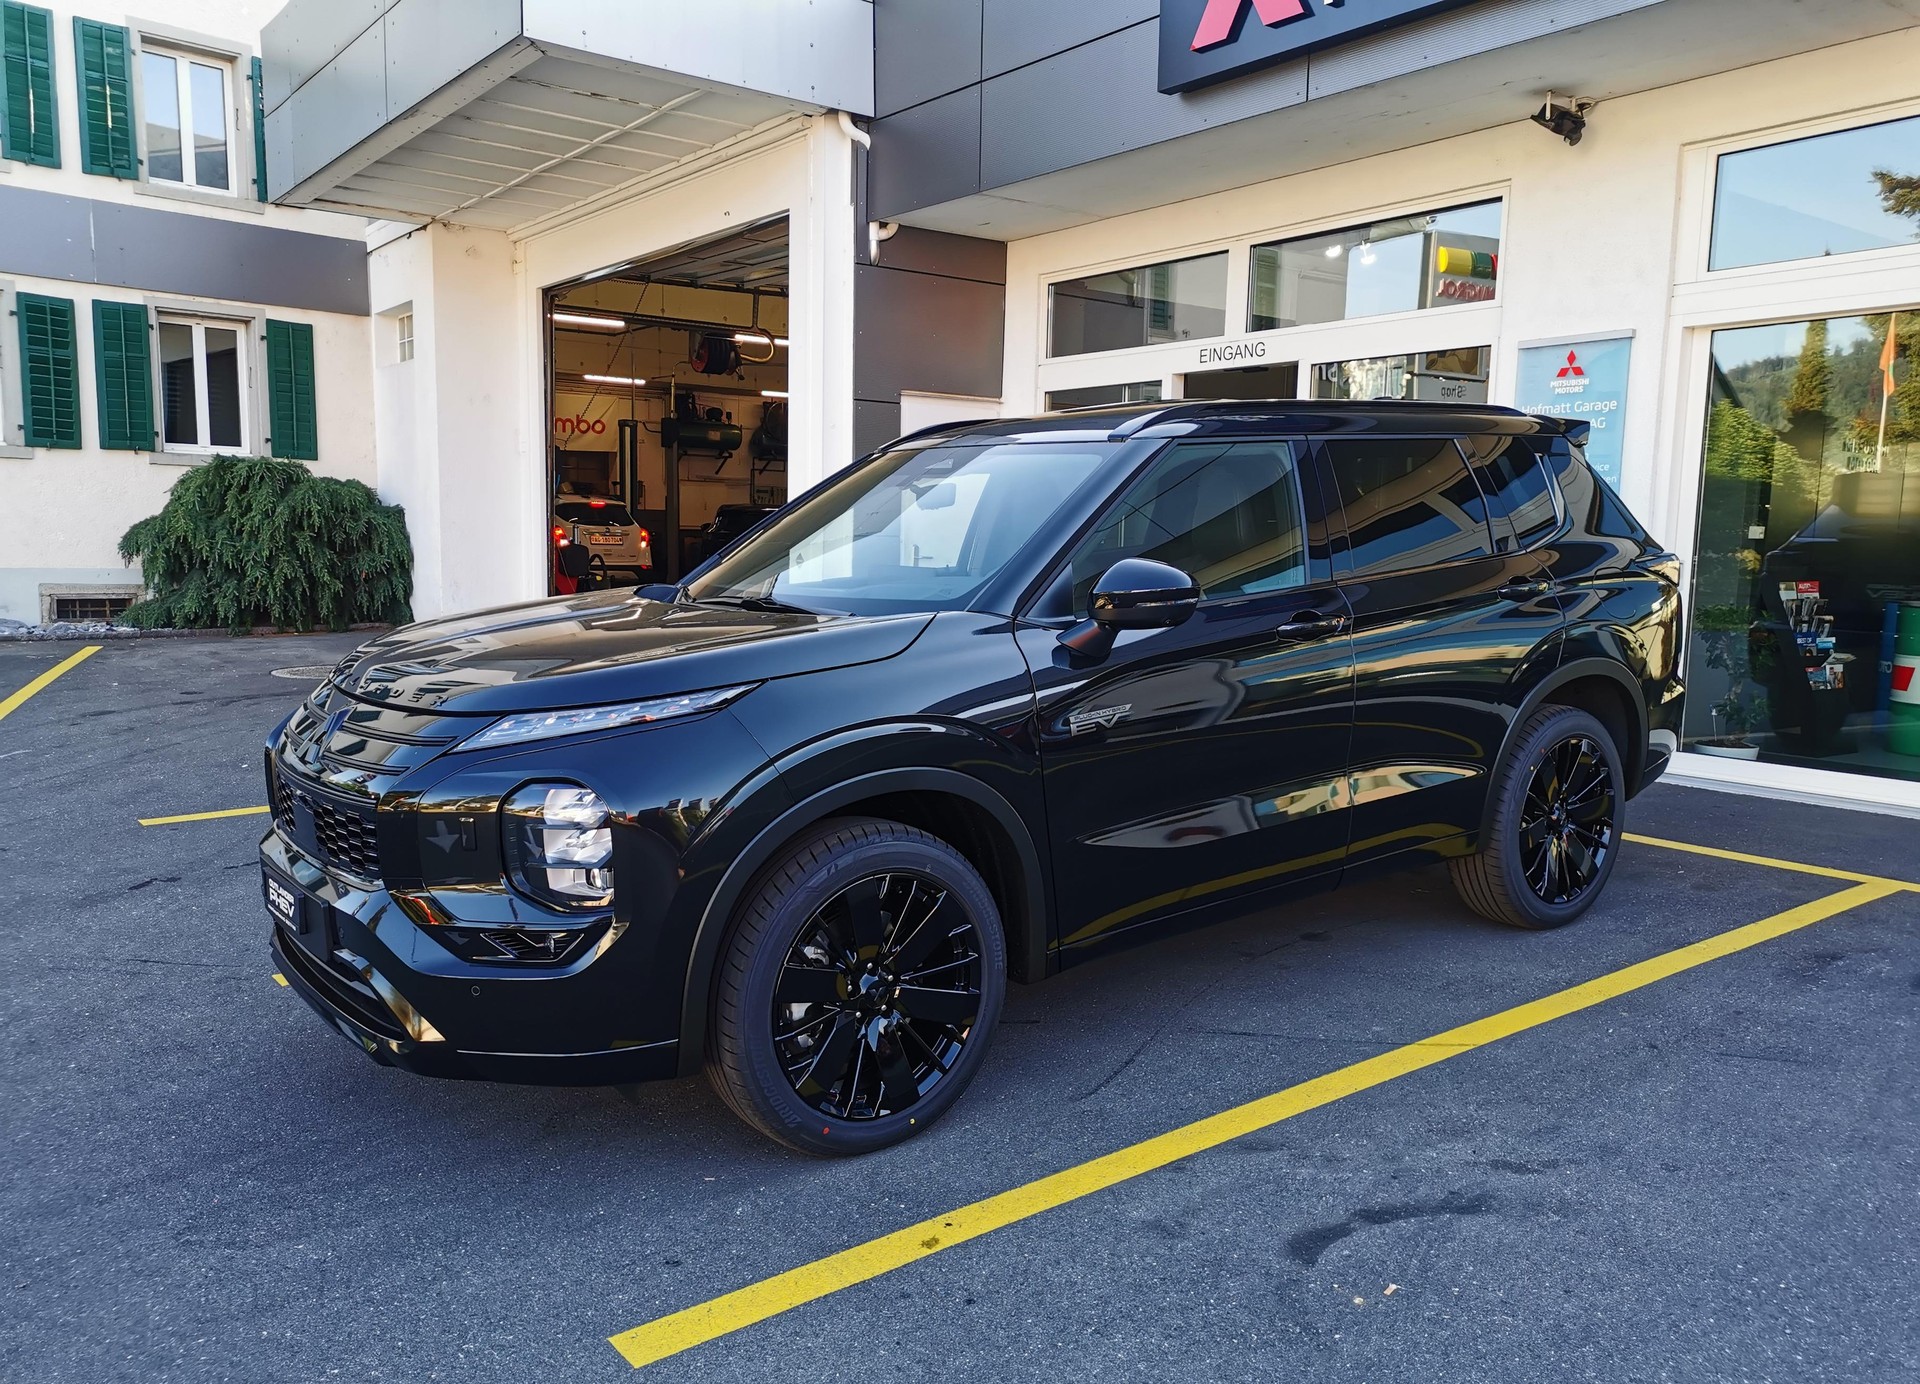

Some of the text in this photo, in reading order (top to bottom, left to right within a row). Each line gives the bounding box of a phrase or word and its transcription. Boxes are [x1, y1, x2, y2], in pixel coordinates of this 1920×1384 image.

[1199, 341, 1267, 363] EINGANG
[1550, 378, 1590, 389] MITSUBISHI
[1554, 386, 1584, 395] MOTORS
[1521, 400, 1618, 415] Hofmatt Garage
[1069, 712, 1122, 737] EV
[269, 887, 295, 918] PHEV
